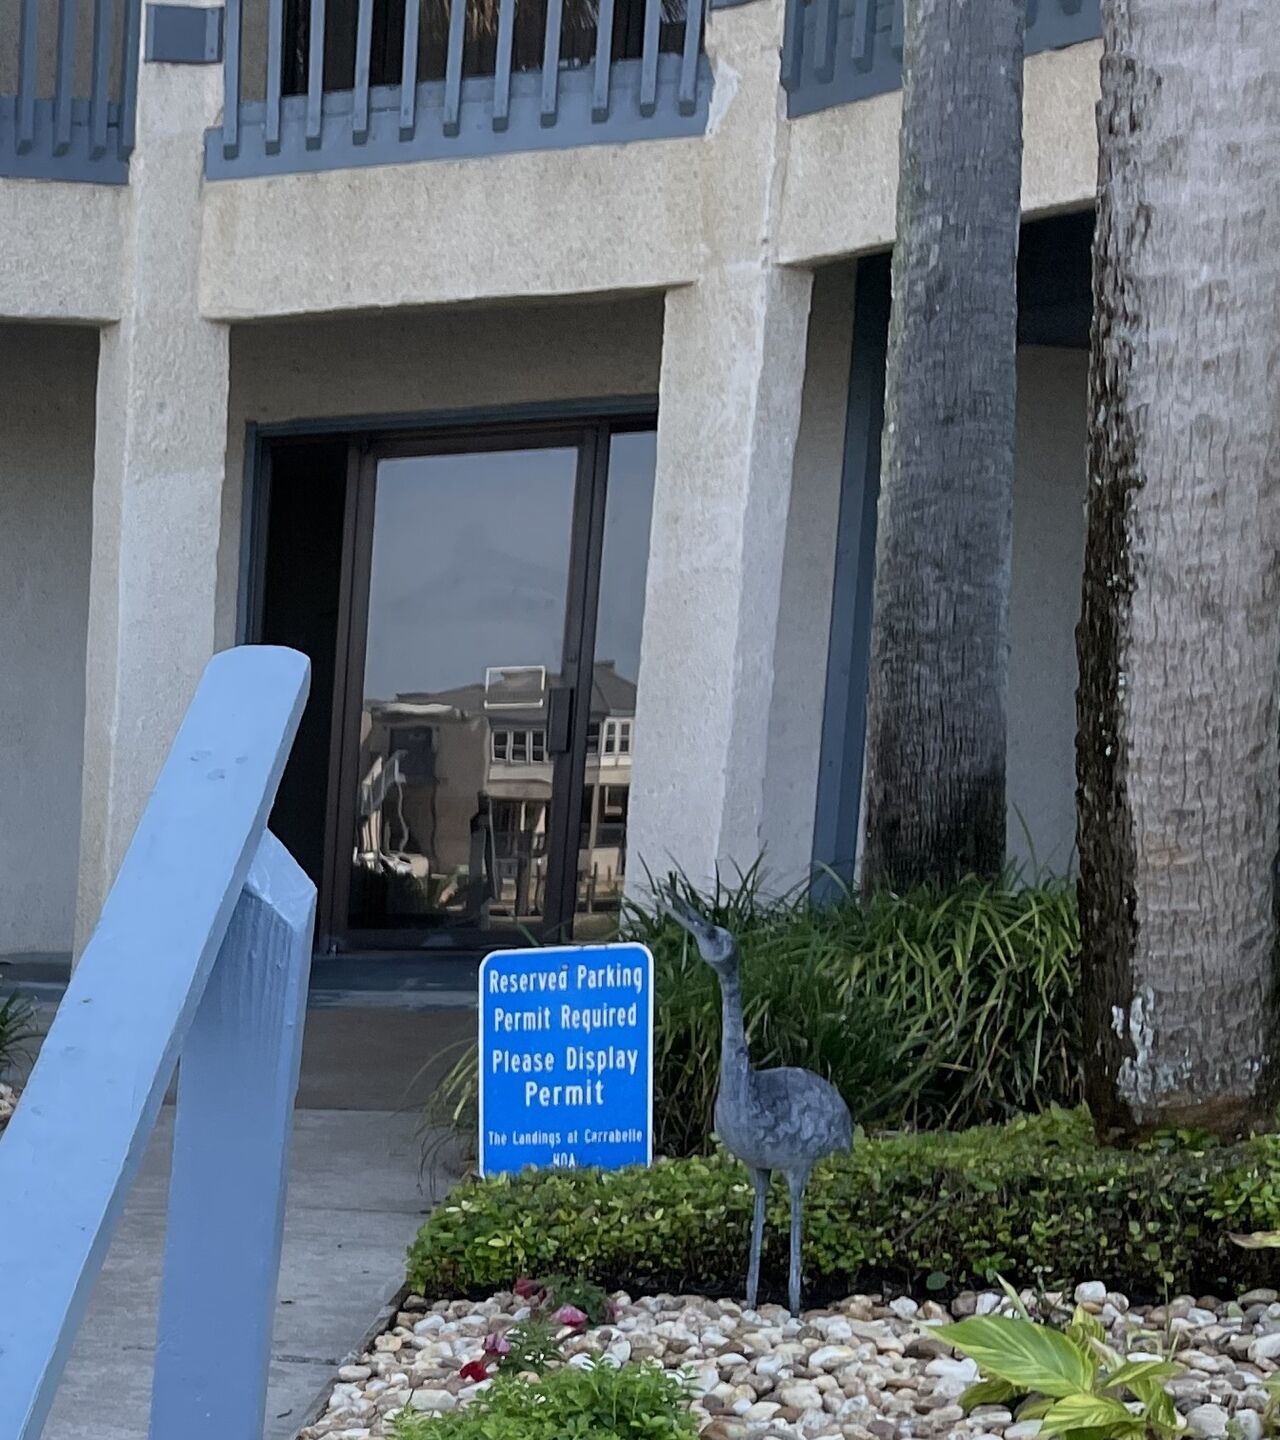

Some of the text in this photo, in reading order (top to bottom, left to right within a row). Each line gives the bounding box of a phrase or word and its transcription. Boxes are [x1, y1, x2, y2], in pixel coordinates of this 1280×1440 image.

[489, 963, 642, 993] Reserved Parking
[494, 1003, 637, 1034] Permit Required
[492, 1046, 638, 1075] Please Display
[525, 1079, 604, 1106] Permit
[488, 1128, 642, 1148] The Landings at Carrabelle
[553, 1152, 576, 1168] HOA
